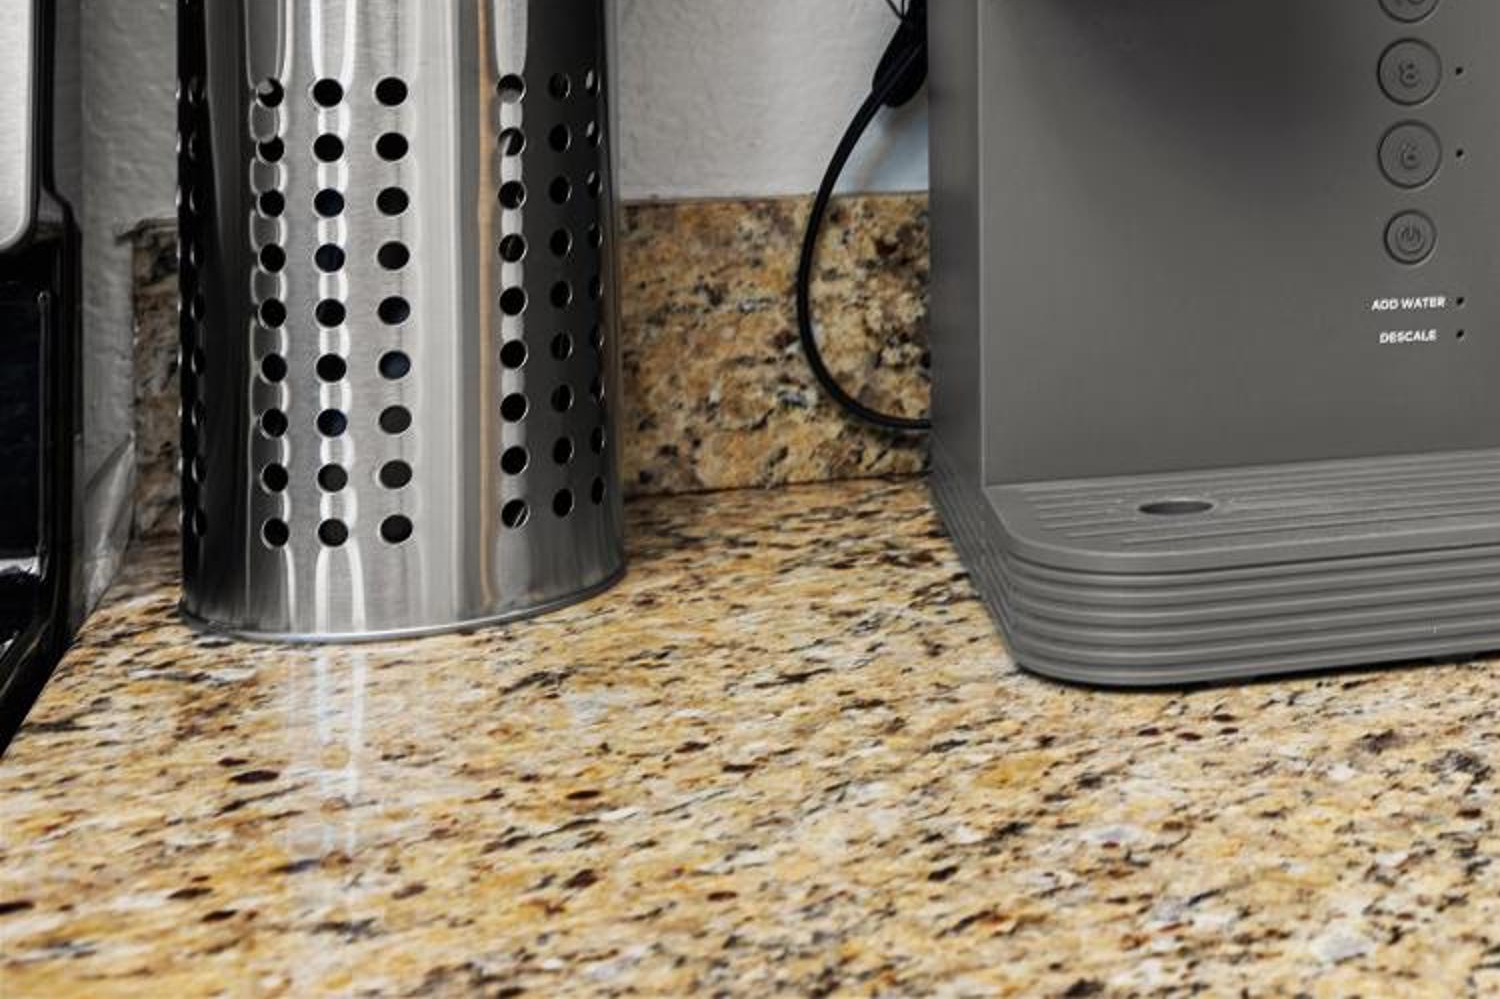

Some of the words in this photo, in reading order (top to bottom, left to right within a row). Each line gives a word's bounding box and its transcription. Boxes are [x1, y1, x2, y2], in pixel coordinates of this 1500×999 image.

[1371, 298, 1399, 312] ADD
[1401, 296, 1446, 310] WATER
[1379, 329, 1438, 344] DESCALE
